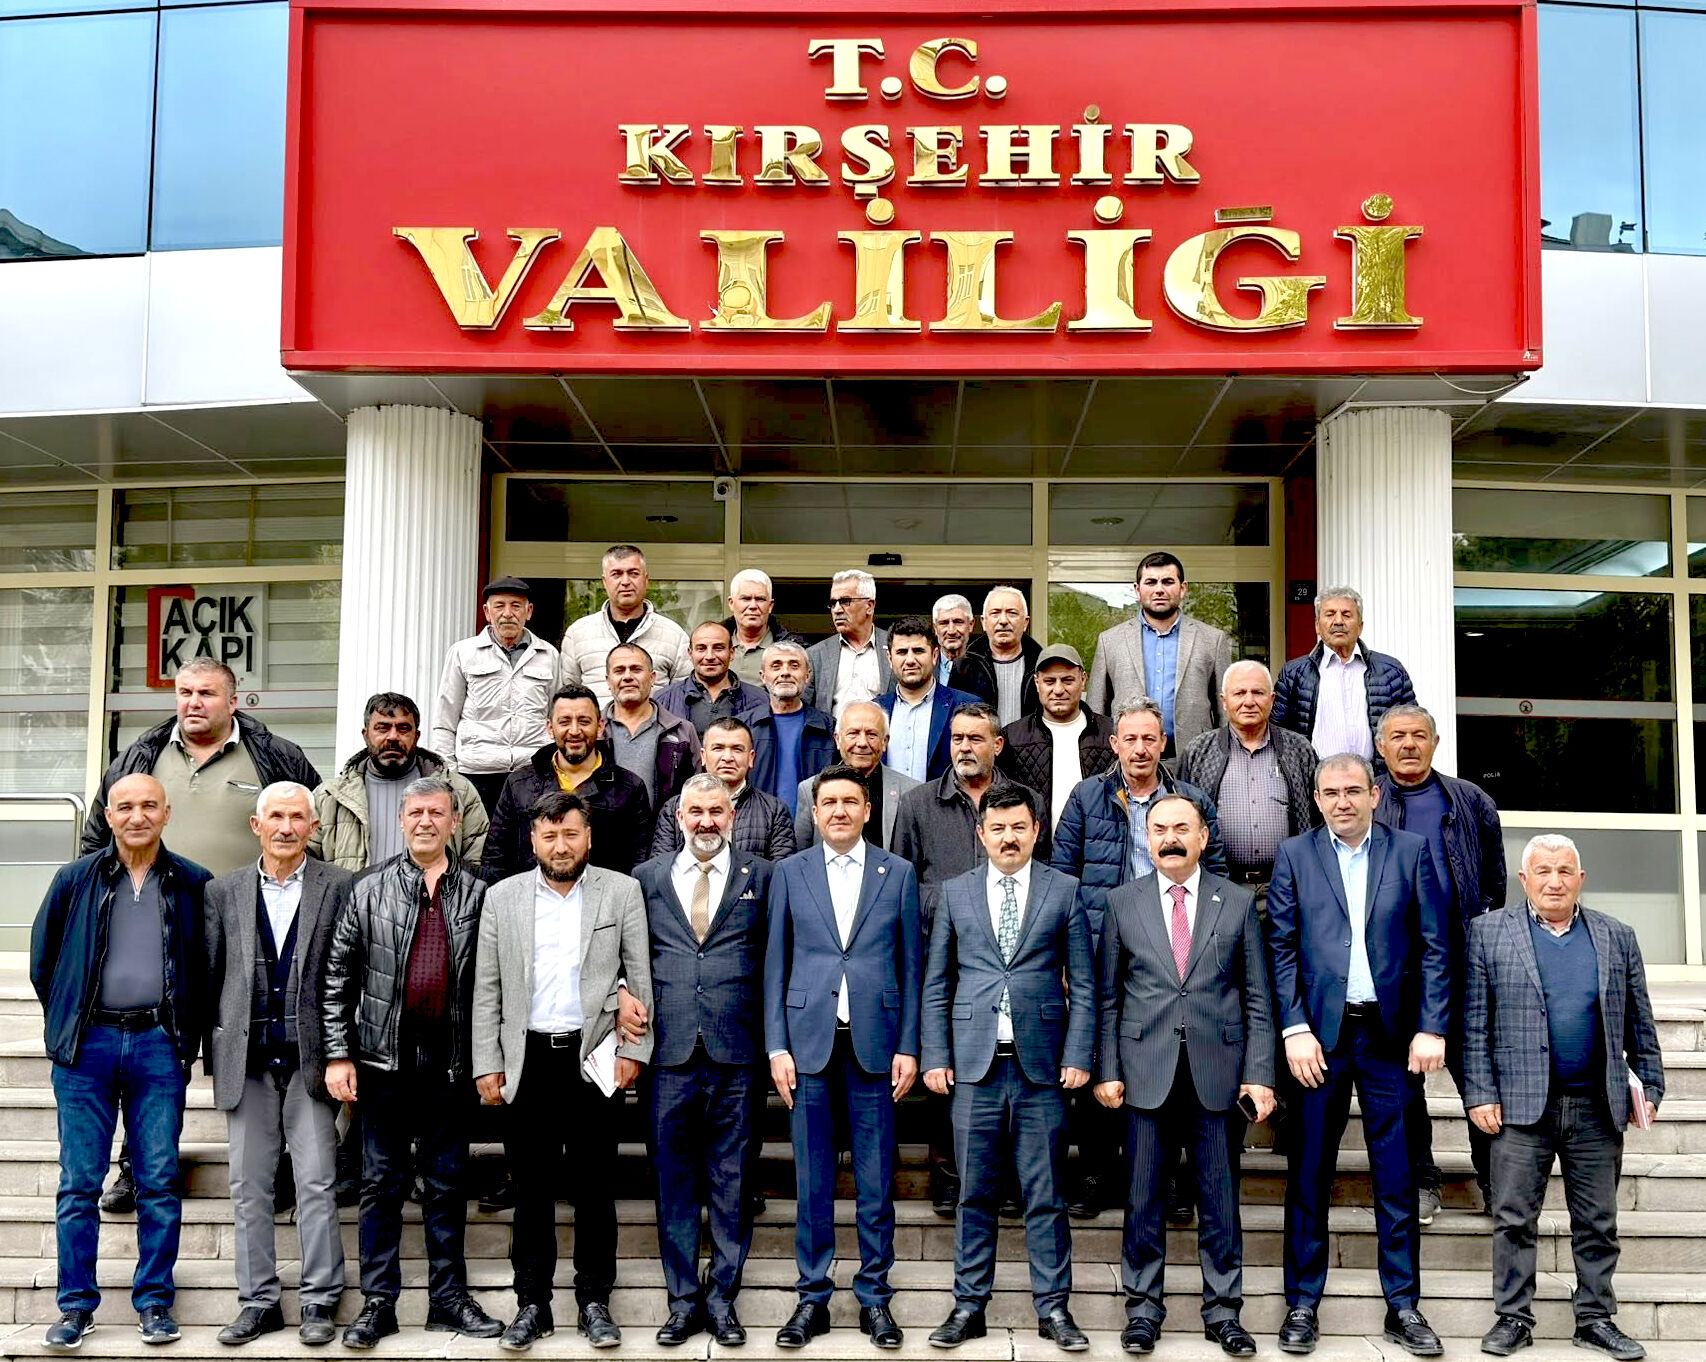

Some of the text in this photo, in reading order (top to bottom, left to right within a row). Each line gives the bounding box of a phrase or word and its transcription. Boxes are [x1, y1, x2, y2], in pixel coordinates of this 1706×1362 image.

[808, 38, 1007, 99] T.C.
[617, 104, 1200, 199] KIRŞEHİR
[392, 193, 1424, 333] VALİLİĞİ
[162, 596, 254, 637] AÇIK
[1297, 587, 1308, 596] 29
